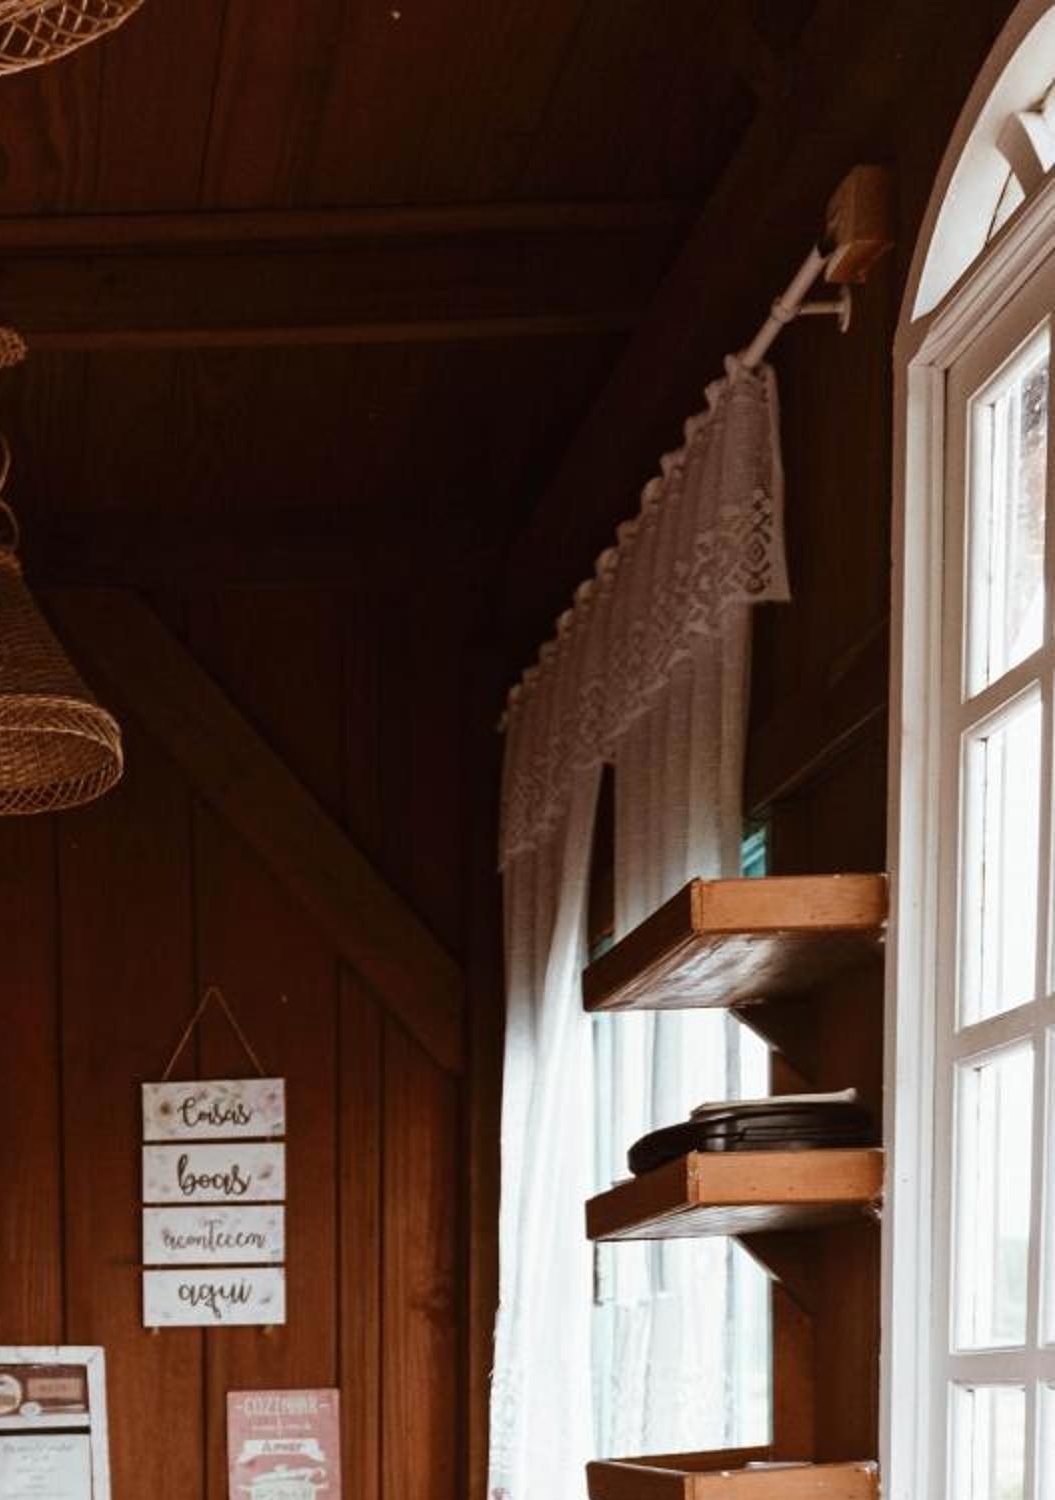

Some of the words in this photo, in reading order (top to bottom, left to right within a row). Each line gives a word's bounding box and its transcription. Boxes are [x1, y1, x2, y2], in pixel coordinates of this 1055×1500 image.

[177, 1096, 253, 1127] Coisas
[177, 1153, 251, 1196] boas
[178, 1278, 253, 1320] aqui
